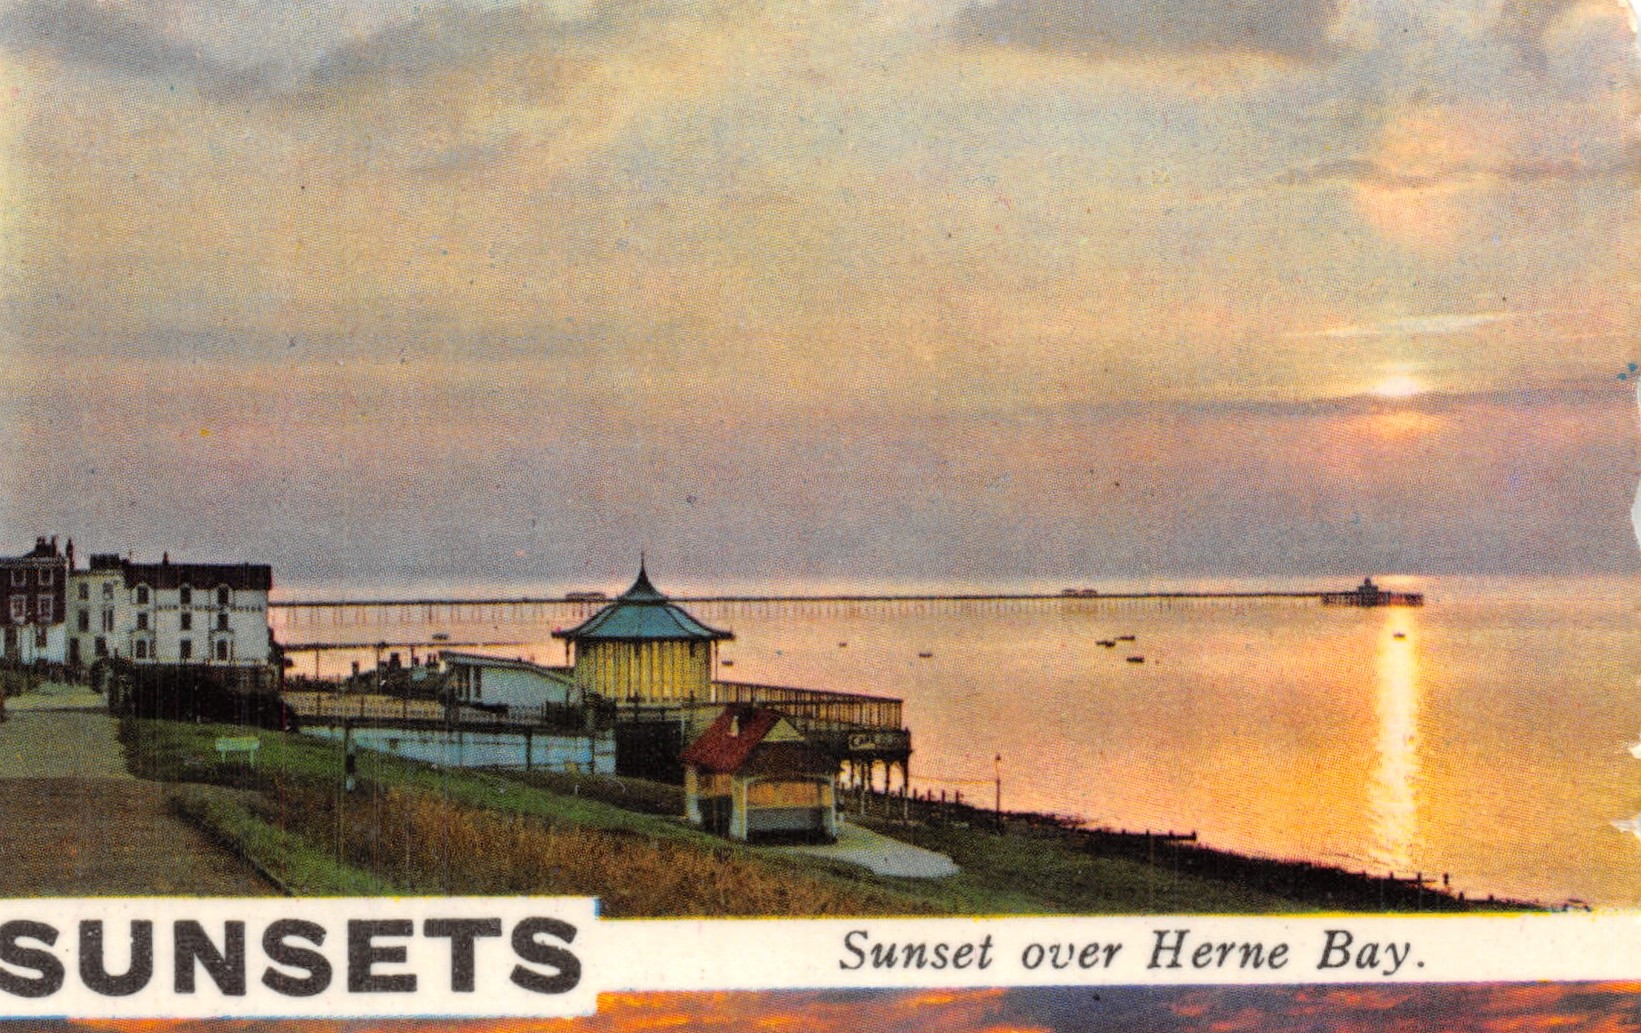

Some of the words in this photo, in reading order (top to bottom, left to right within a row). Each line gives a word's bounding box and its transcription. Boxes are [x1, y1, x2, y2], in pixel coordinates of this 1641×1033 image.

[839, 930, 993, 970] Sunset
[1021, 942, 1123, 970] over
[1147, 929, 1289, 969] Herne
[1316, 929, 1425, 978] Bay.
